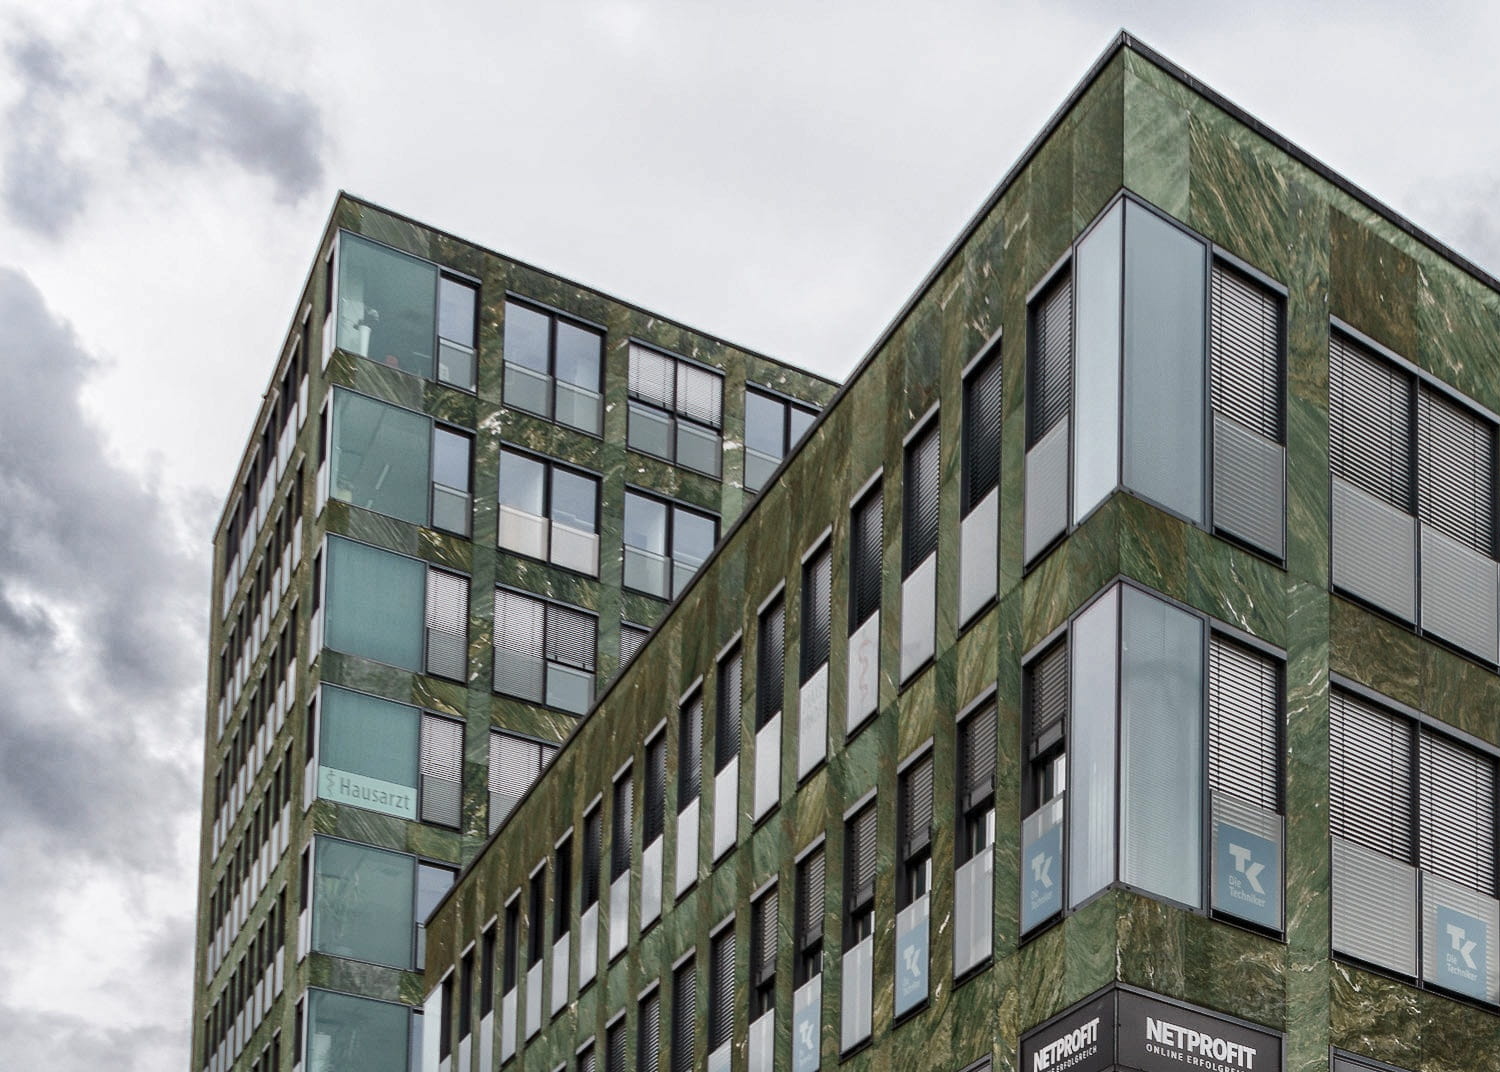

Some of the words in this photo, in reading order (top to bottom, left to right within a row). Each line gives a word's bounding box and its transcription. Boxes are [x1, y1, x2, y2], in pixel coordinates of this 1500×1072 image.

[340, 776, 411, 810] Hausarzt
[1229, 843, 1265, 895] TK
[1446, 923, 1477, 970] TK
[1146, 1016, 1257, 1070] NETPROFIT
[1146, 1043, 1184, 1062] ONLINE
